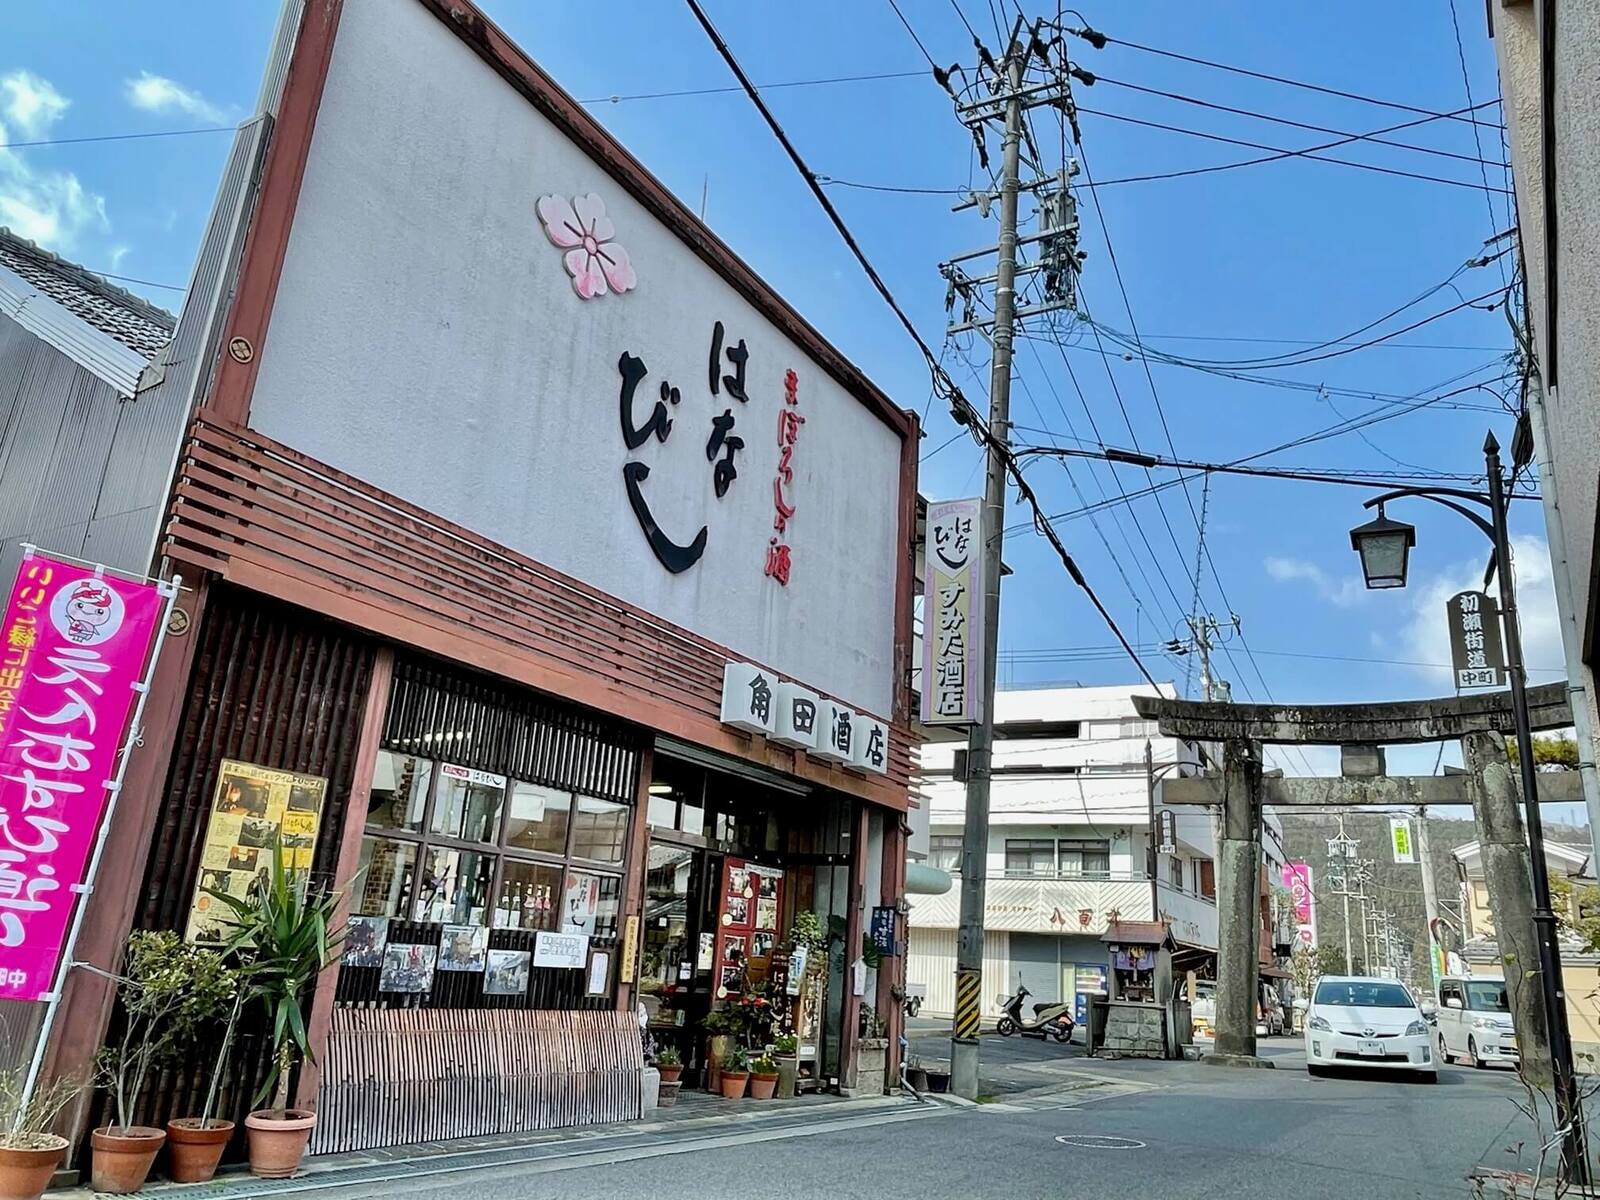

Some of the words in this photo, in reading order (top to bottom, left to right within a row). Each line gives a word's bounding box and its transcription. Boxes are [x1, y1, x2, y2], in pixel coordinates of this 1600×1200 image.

[935, 582, 966, 716] すみた酒店
[1460, 594, 1488, 669] 初瀬街道
[1462, 670, 1493, 685] 中町
[748, 673, 884, 768] 角田酒店
